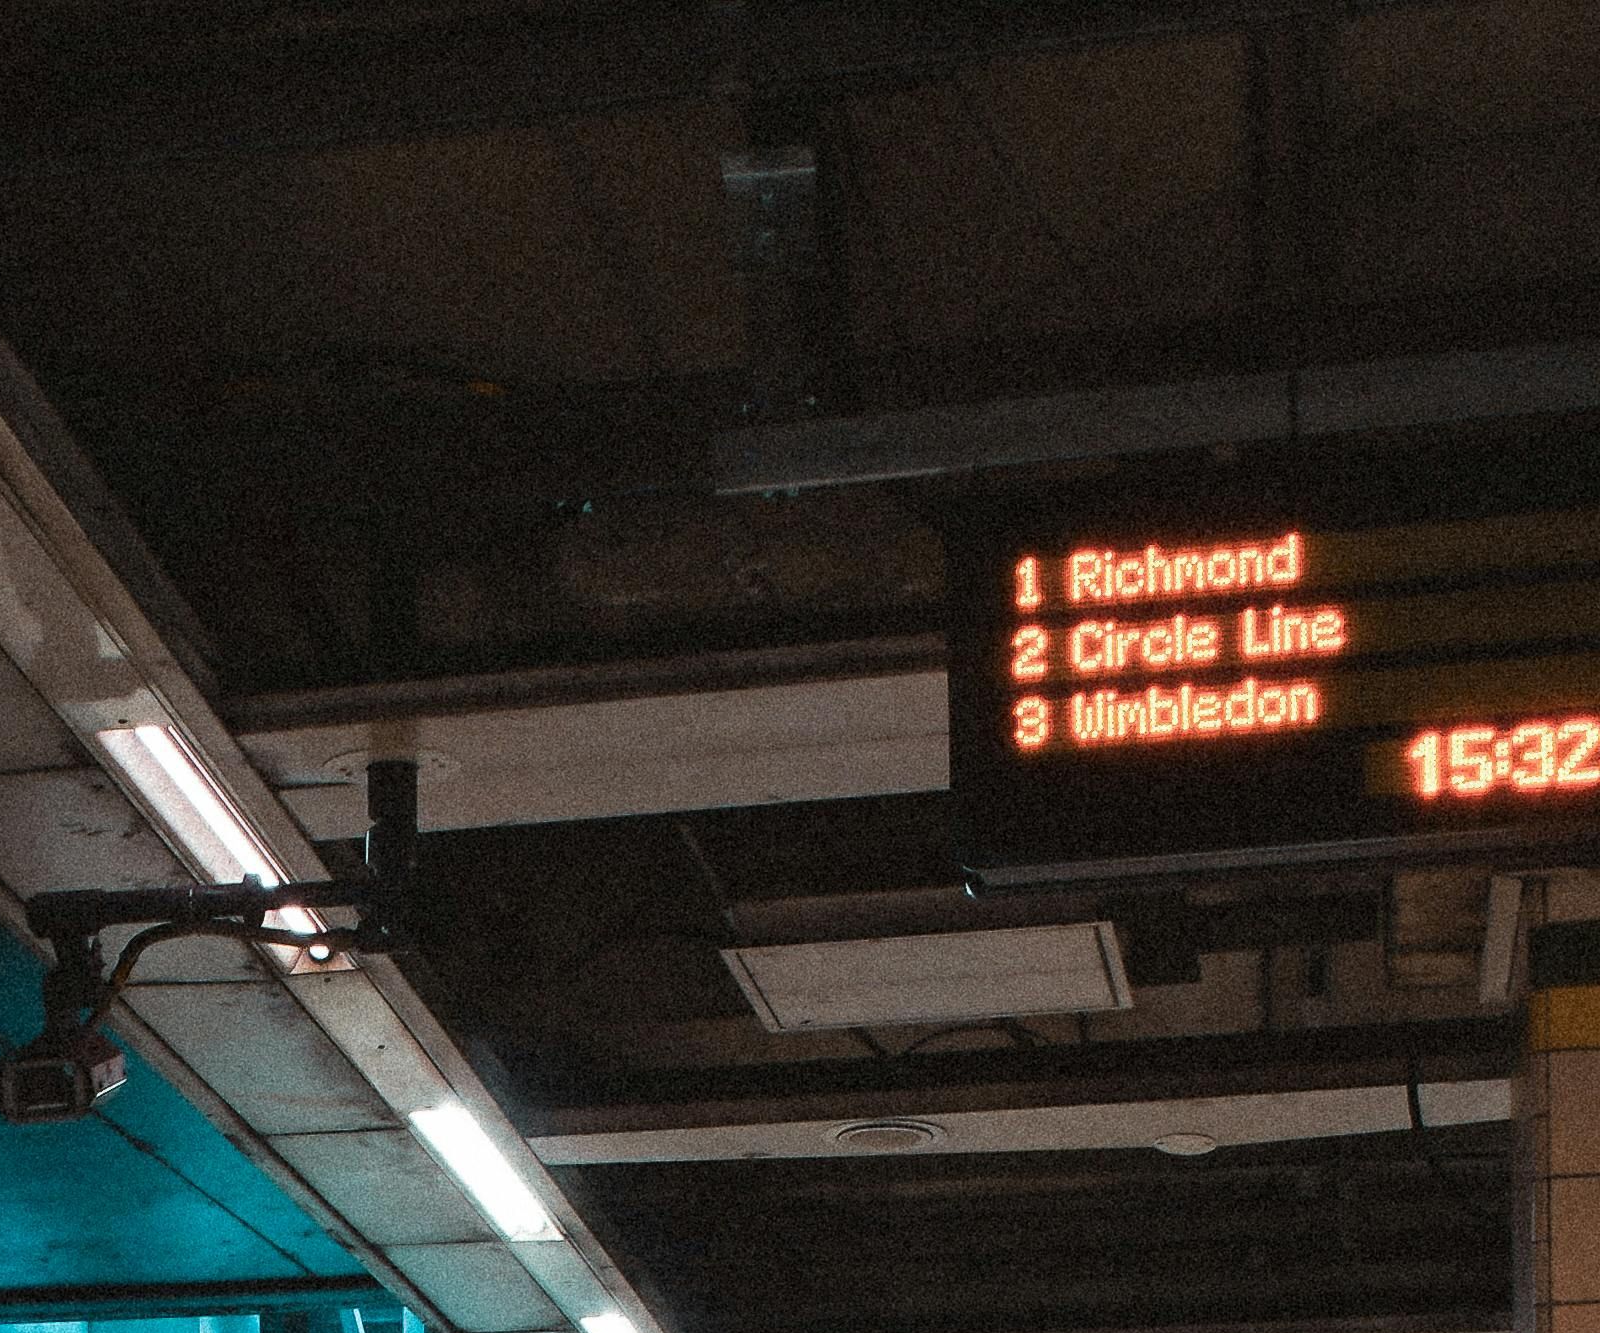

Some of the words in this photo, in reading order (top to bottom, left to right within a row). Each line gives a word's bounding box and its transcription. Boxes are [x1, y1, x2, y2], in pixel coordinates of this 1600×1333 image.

[1015, 554, 1041, 607] 1
[1069, 531, 1300, 601] Richmond
[1012, 626, 1047, 677] 2
[1070, 612, 1219, 670] Circle
[1241, 605, 1343, 656] Line
[1013, 698, 1049, 746] 3
[1071, 678, 1317, 740] Wimbledon
[1410, 720, 1600, 796] 15:32
